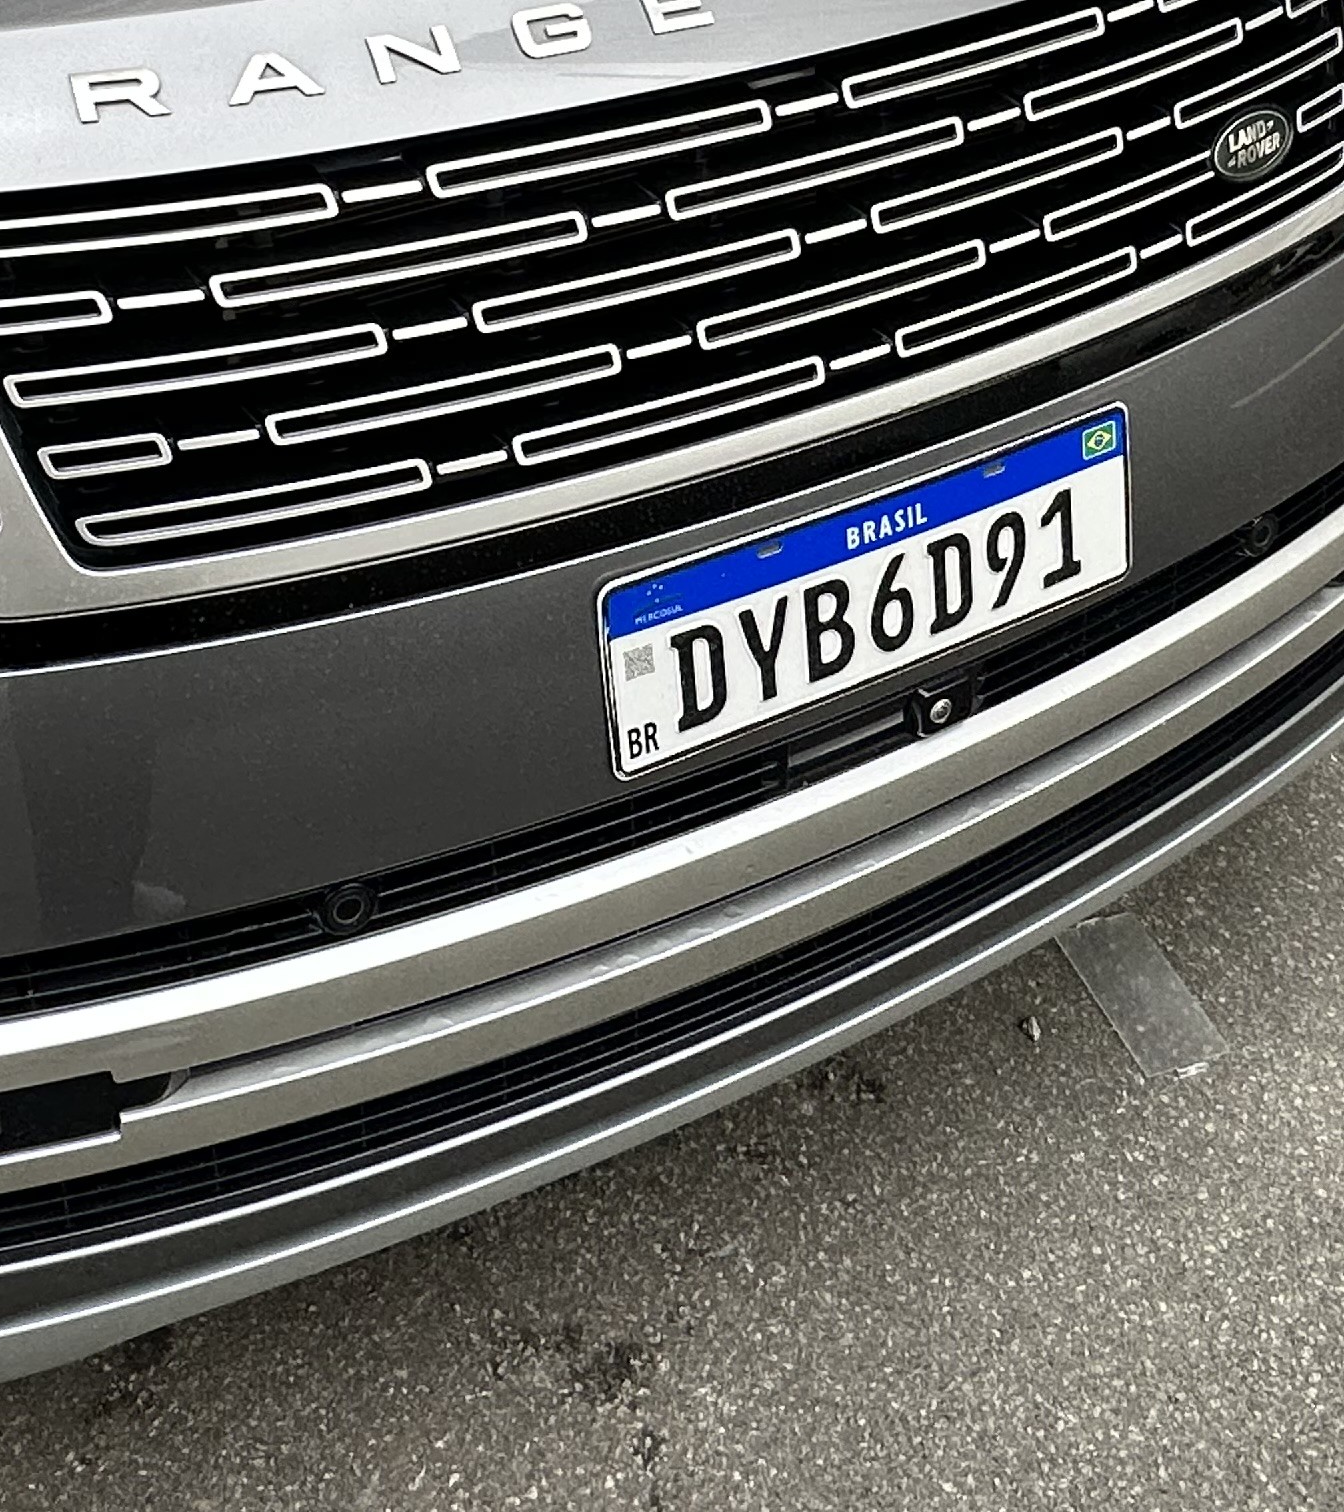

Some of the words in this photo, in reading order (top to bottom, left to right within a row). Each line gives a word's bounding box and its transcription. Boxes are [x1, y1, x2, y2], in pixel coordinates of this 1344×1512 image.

[1228, 120, 1267, 153] LAND
[1237, 131, 1281, 168] ROVER
[845, 502, 929, 551] BRASIL
[670, 487, 1082, 733] DYB6D91
[626, 721, 660, 760] BR
